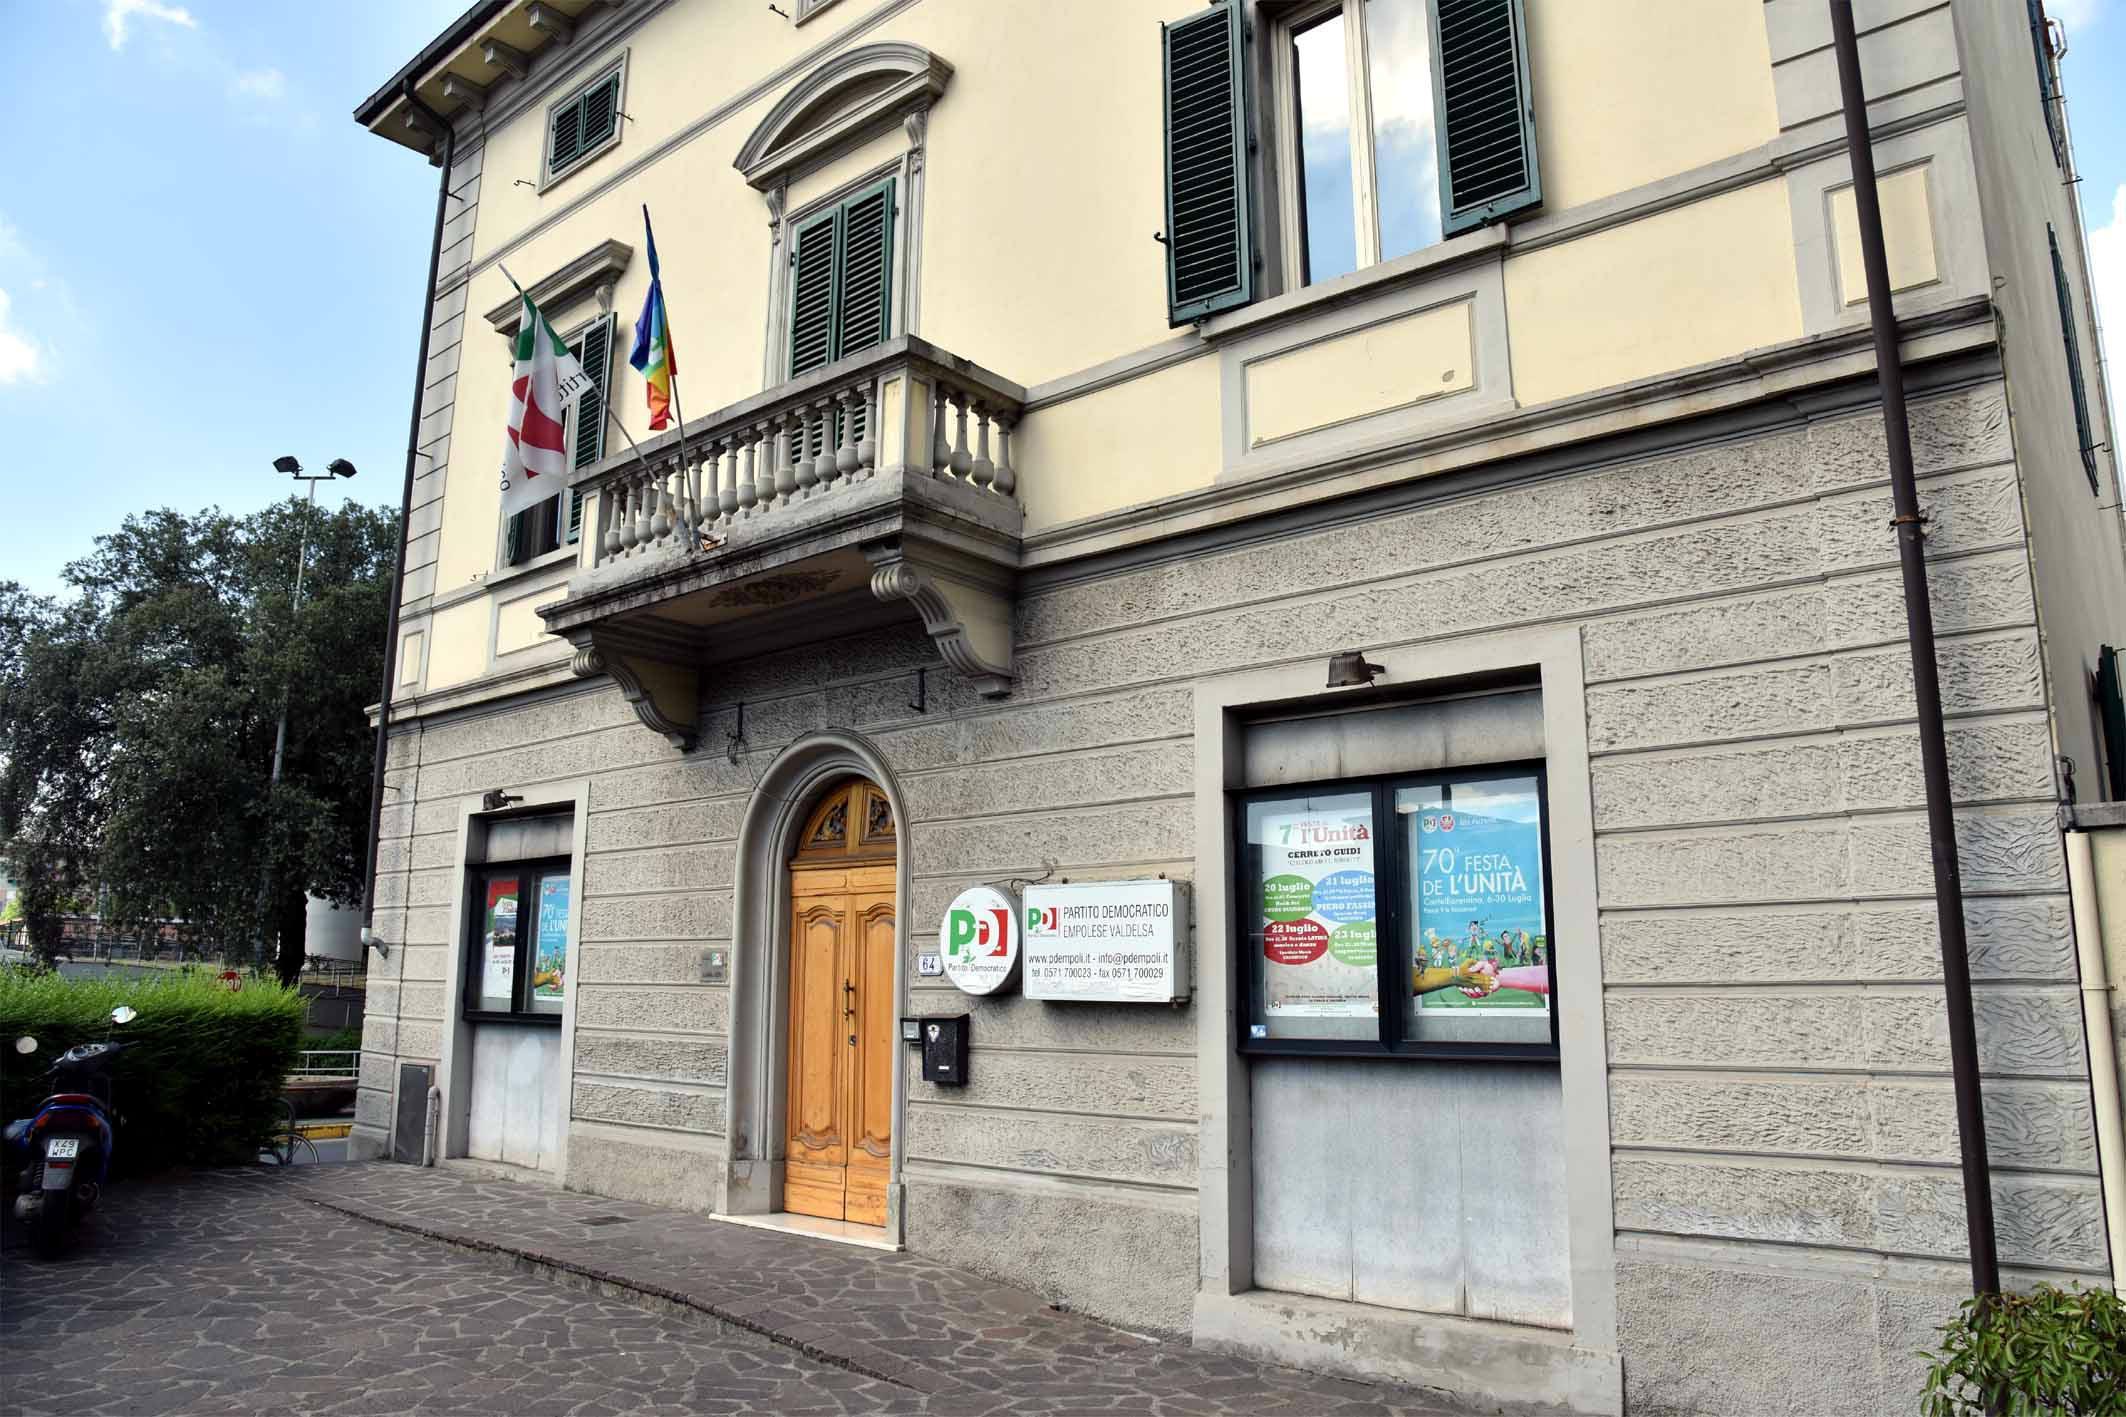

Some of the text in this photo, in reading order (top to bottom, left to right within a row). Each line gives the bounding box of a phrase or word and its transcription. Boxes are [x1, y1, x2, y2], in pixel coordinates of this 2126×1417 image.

[1334, 847, 1361, 856] GUIDI
[1465, 854, 1512, 872] FESTA
[1278, 882, 1311, 893] luglio
[1423, 866, 1527, 896] DE L'UNITÀ
[1063, 906, 1099, 919] PARTITO
[1102, 903, 1169, 919] DEMOCRATICO
[1063, 923, 1155, 938] EMPOLESE VALDELSA
[1271, 923, 1319, 935] 22 luglio
[922, 957, 935, 970] 64
[1028, 952, 1091, 966] www.pdempoli.it
[1098, 952, 1169, 966] info@pdempoli.it
[971, 964, 1008, 973] Democratico
[1044, 967, 1061, 977] 0571
[1064, 967, 1092, 978] 700023
[1099, 967, 1109, 977] fax
[1112, 967, 1130, 978] 0571
[1134, 967, 1164, 978] 700029
